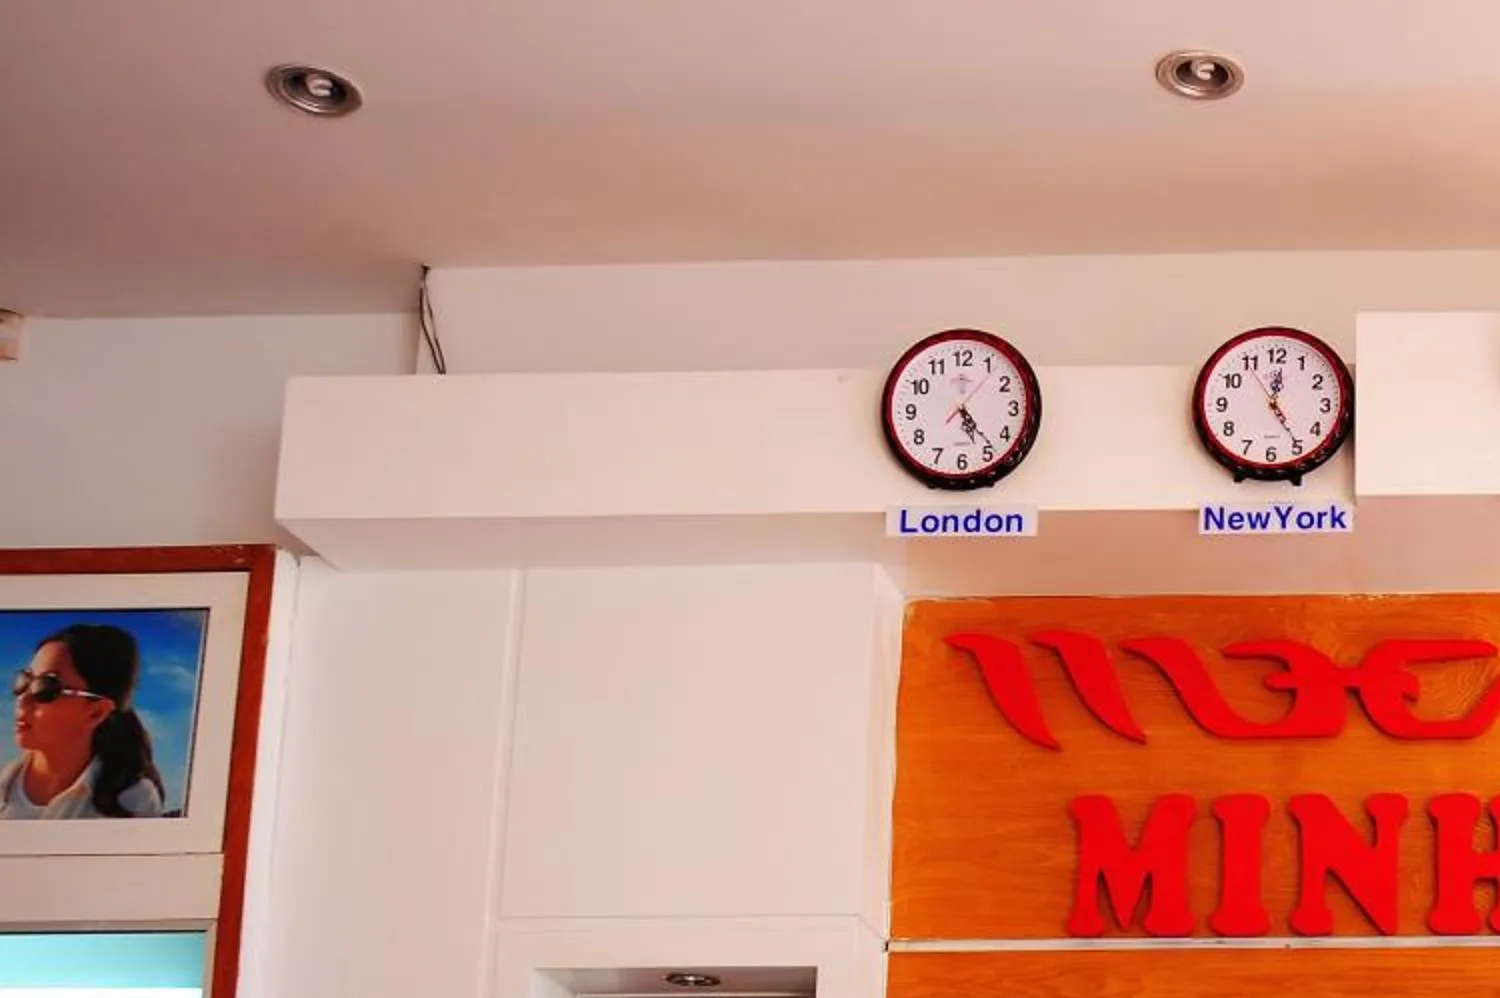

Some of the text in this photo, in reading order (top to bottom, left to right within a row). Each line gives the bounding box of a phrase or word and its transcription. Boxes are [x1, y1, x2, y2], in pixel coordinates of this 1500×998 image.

[953, 350, 973, 367] 12
[1242, 355, 1258, 371] 11
[1268, 348, 1287, 364] 12
[1297, 356, 1305, 371] 1
[928, 359, 945, 375] 11
[983, 357, 991, 373] 1
[911, 378, 929, 395] 10
[999, 376, 1011, 392] 2
[1223, 373, 1242, 389] 10
[1312, 374, 1323, 390] 2
[905, 404, 916, 420] 9
[1008, 401, 1019, 417] 3
[1216, 397, 1227, 412] 9
[1319, 398, 1331, 413] 3
[999, 425, 1010, 442] 4
[1223, 421, 1235, 436] 8
[1310, 422, 1321, 436] 4
[913, 429, 925, 445] 8
[982, 446, 993, 462] 5
[1241, 440, 1253, 455] 7
[1266, 447, 1277, 462] 6
[1291, 439, 1303, 455] 5
[932, 448, 944, 464] 7
[957, 453, 967, 470] 6
[899, 509, 1025, 534] London
[1203, 506, 1346, 530] NewYork
